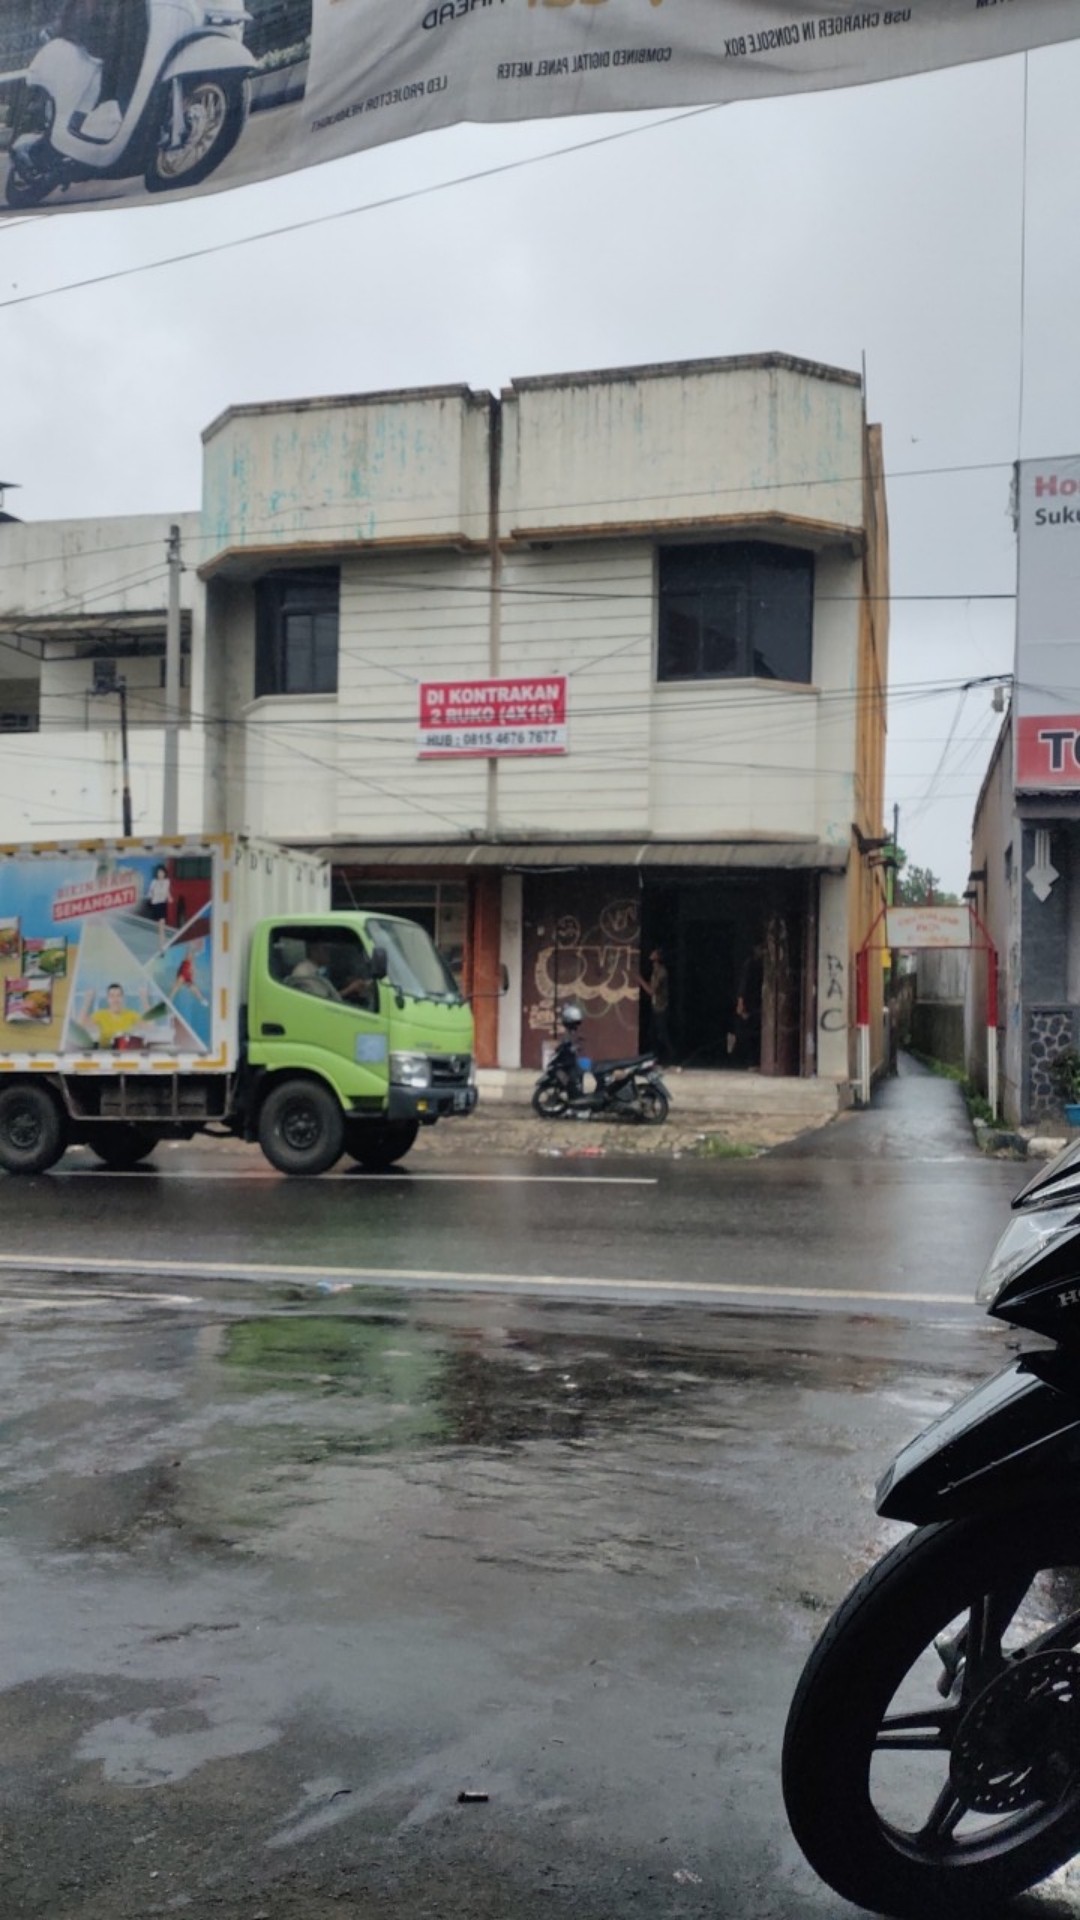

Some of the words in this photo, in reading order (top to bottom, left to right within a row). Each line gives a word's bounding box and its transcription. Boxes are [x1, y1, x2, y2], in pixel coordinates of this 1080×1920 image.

[1035, 475, 1080, 497] Ho
[1035, 505, 1080, 526] Suk
[426, 689, 444, 706] DI
[448, 684, 560, 704] KONTRAKAN
[430, 708, 442, 724] 2
[445, 706, 495, 724] RUKO
[426, 734, 452, 747] HUB
[463, 732, 492, 746] 0815
[1038, 729, 1080, 771] T
[1058, 1289, 1080, 1307] H
